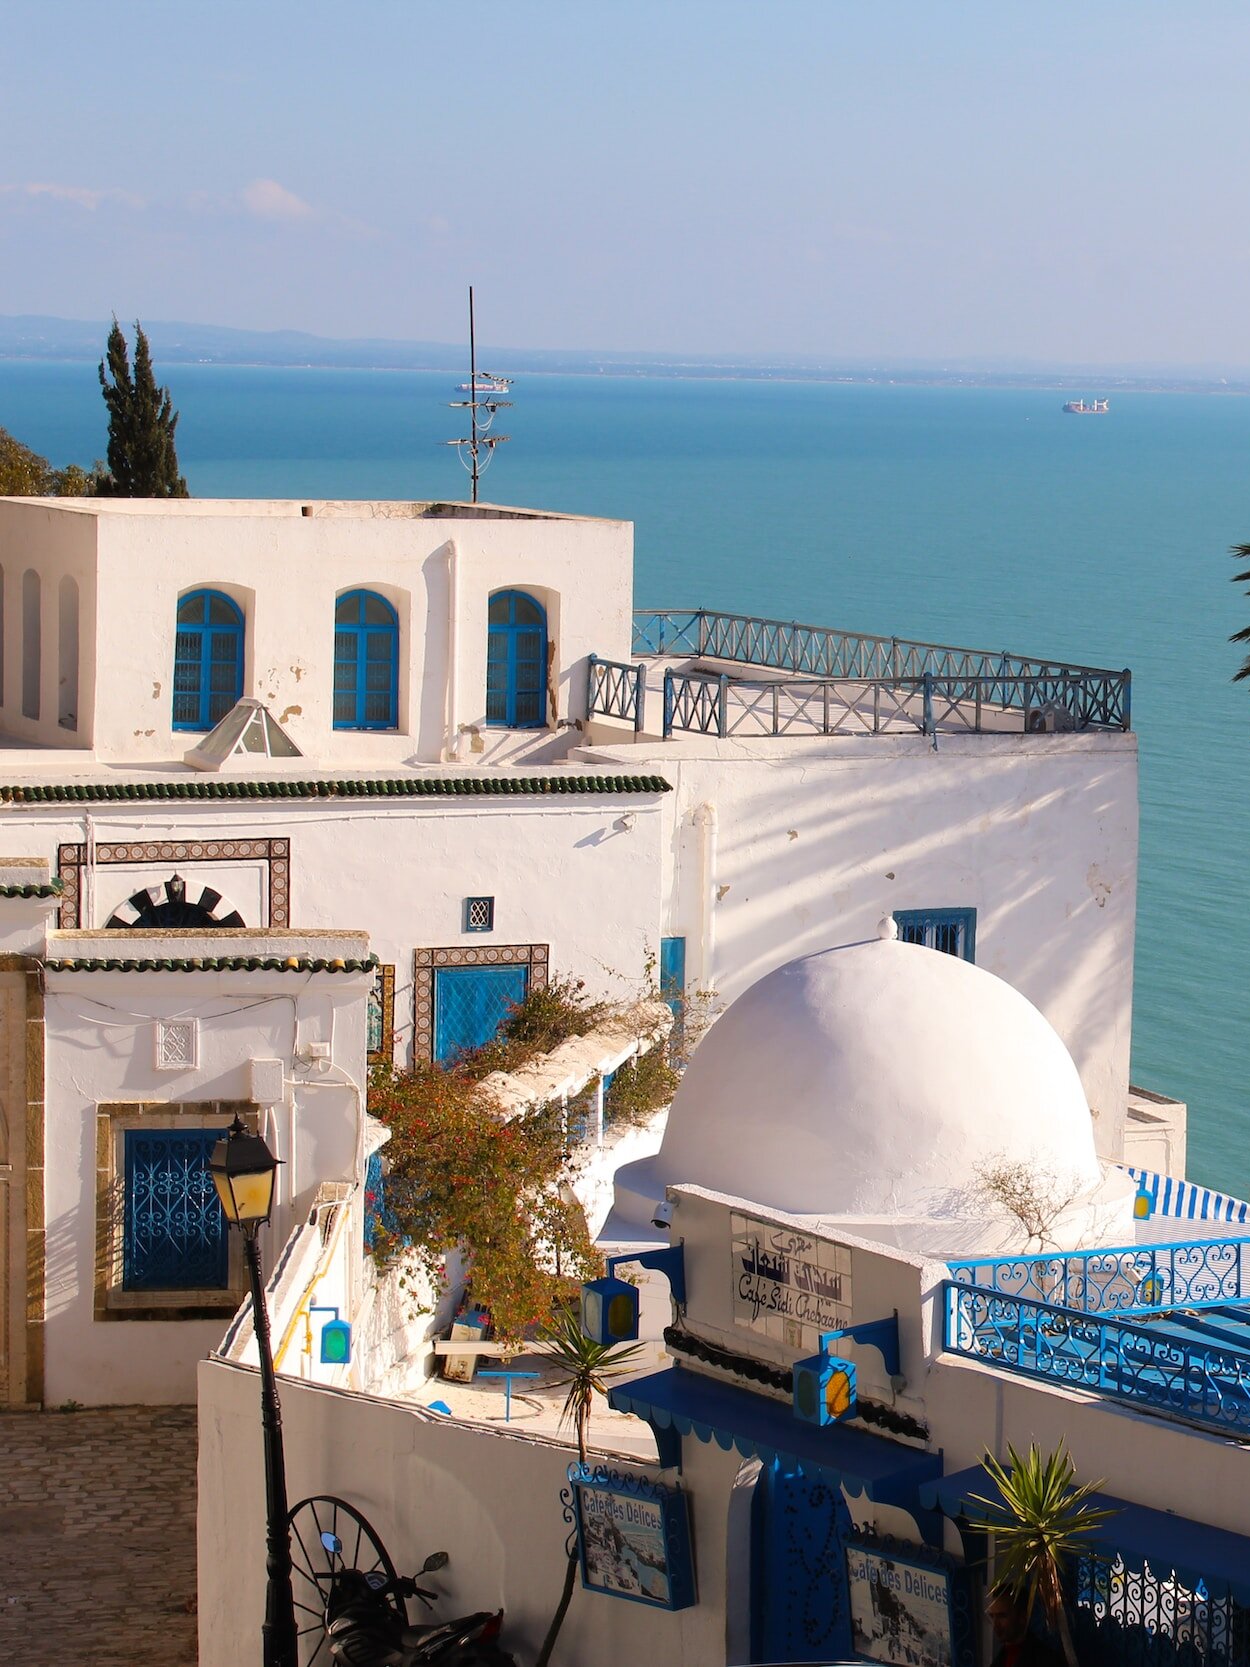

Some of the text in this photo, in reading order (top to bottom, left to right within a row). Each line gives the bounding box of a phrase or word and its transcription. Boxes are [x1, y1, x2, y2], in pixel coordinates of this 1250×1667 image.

[738, 1273, 767, 1323] Café
[767, 1280, 795, 1315] Sidi
[607, 1499, 624, 1520] des
[627, 1501, 662, 1530] Délices
[880, 1563, 901, 1591] des
[904, 1569, 948, 1605] Délices
